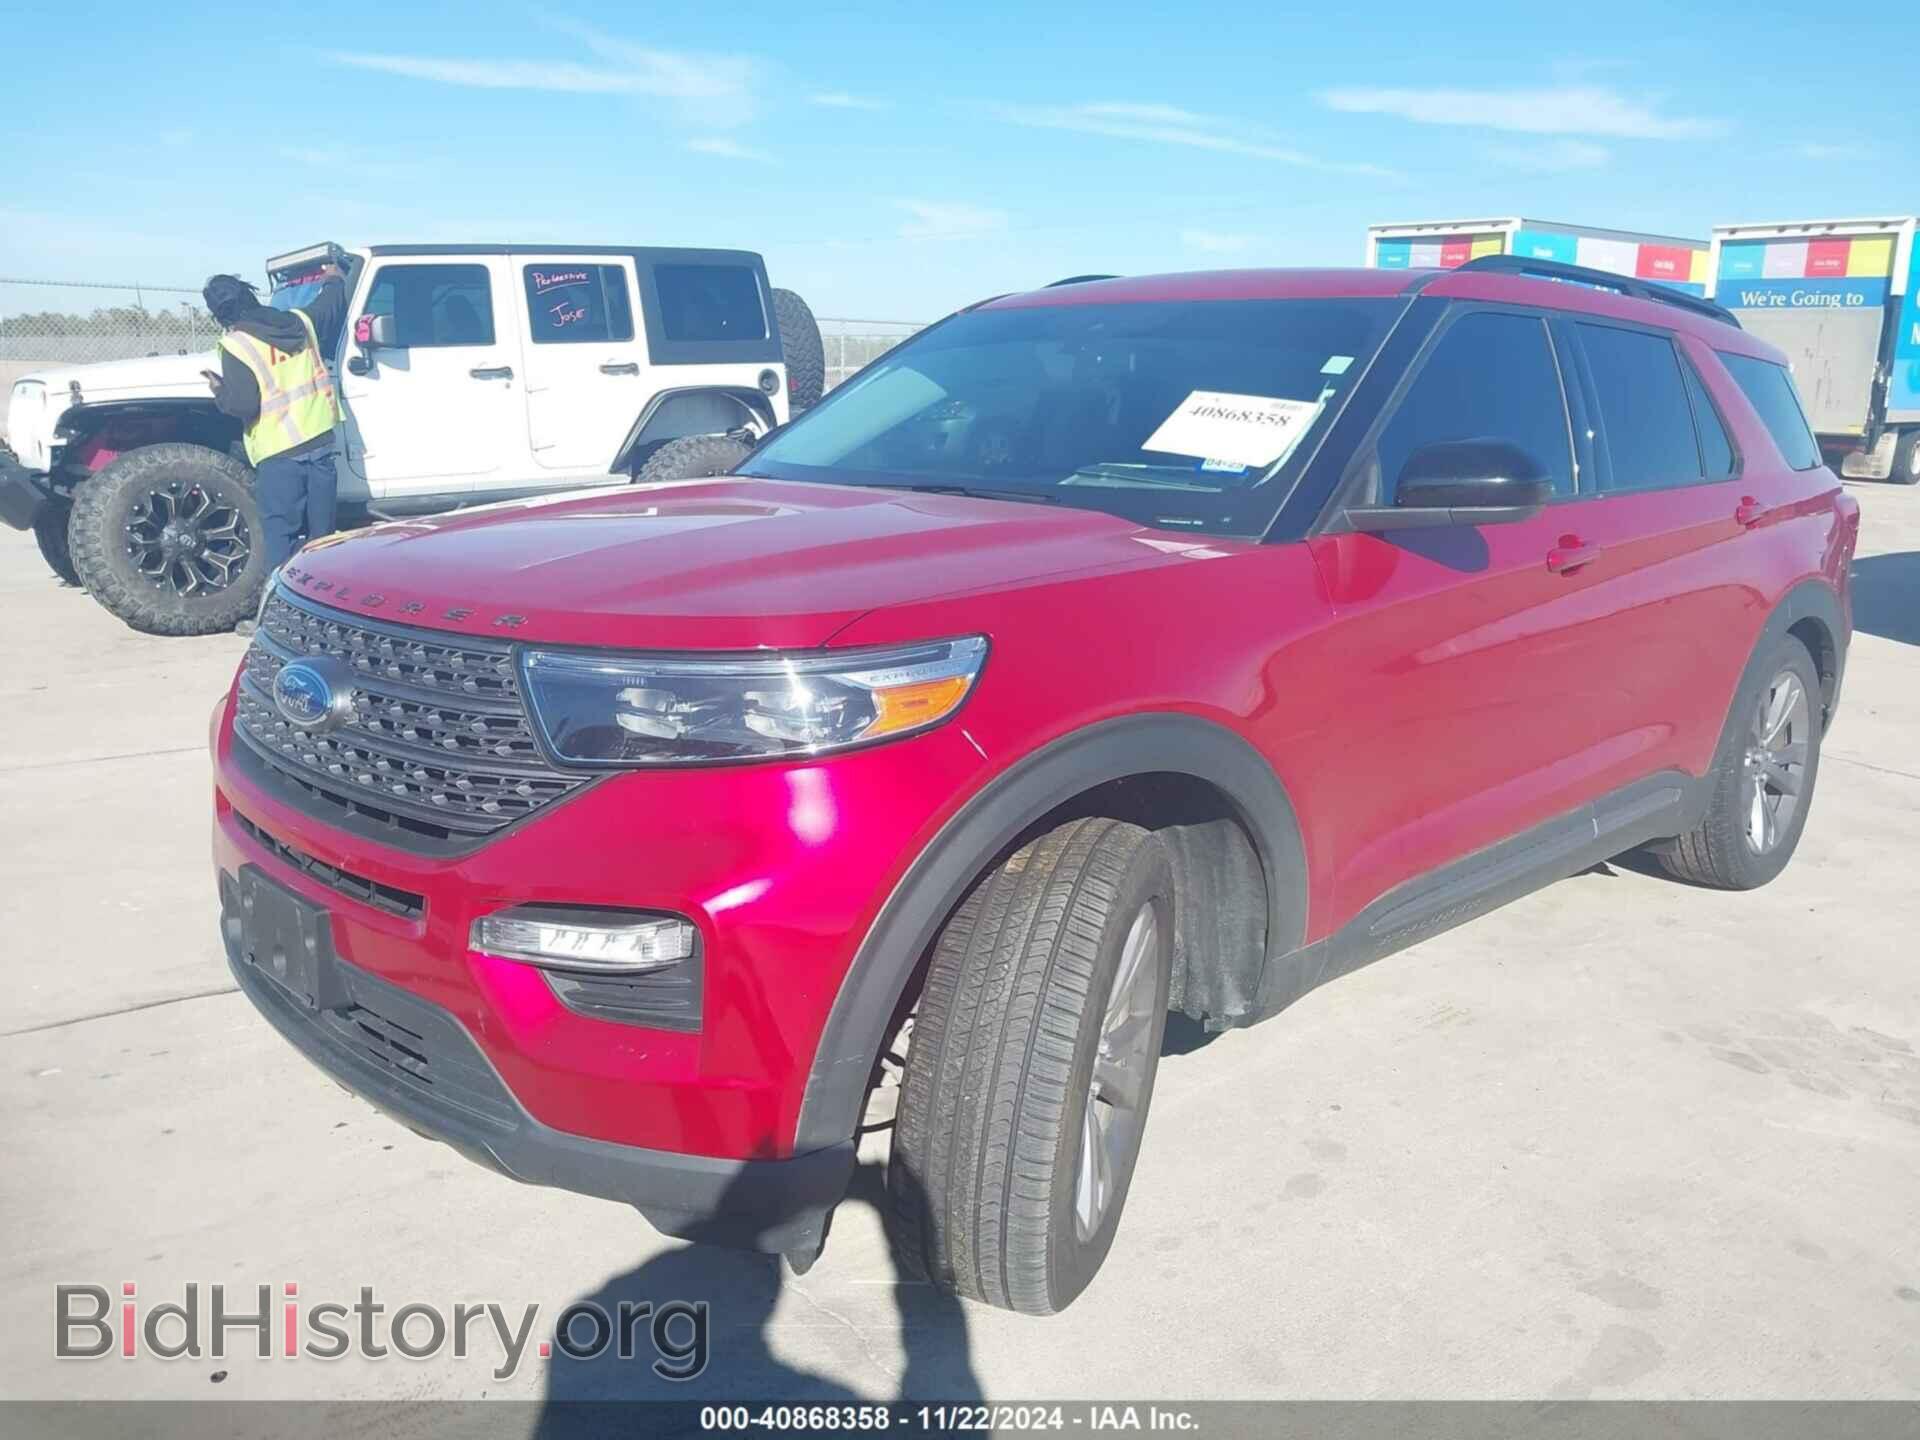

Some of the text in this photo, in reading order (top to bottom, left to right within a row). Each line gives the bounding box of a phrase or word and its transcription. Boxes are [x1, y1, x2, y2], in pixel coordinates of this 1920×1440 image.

[1741, 290, 1864, 308] We're Going to
[1189, 405, 1292, 426] 40868358
[287, 566, 529, 630] EXPLORER
